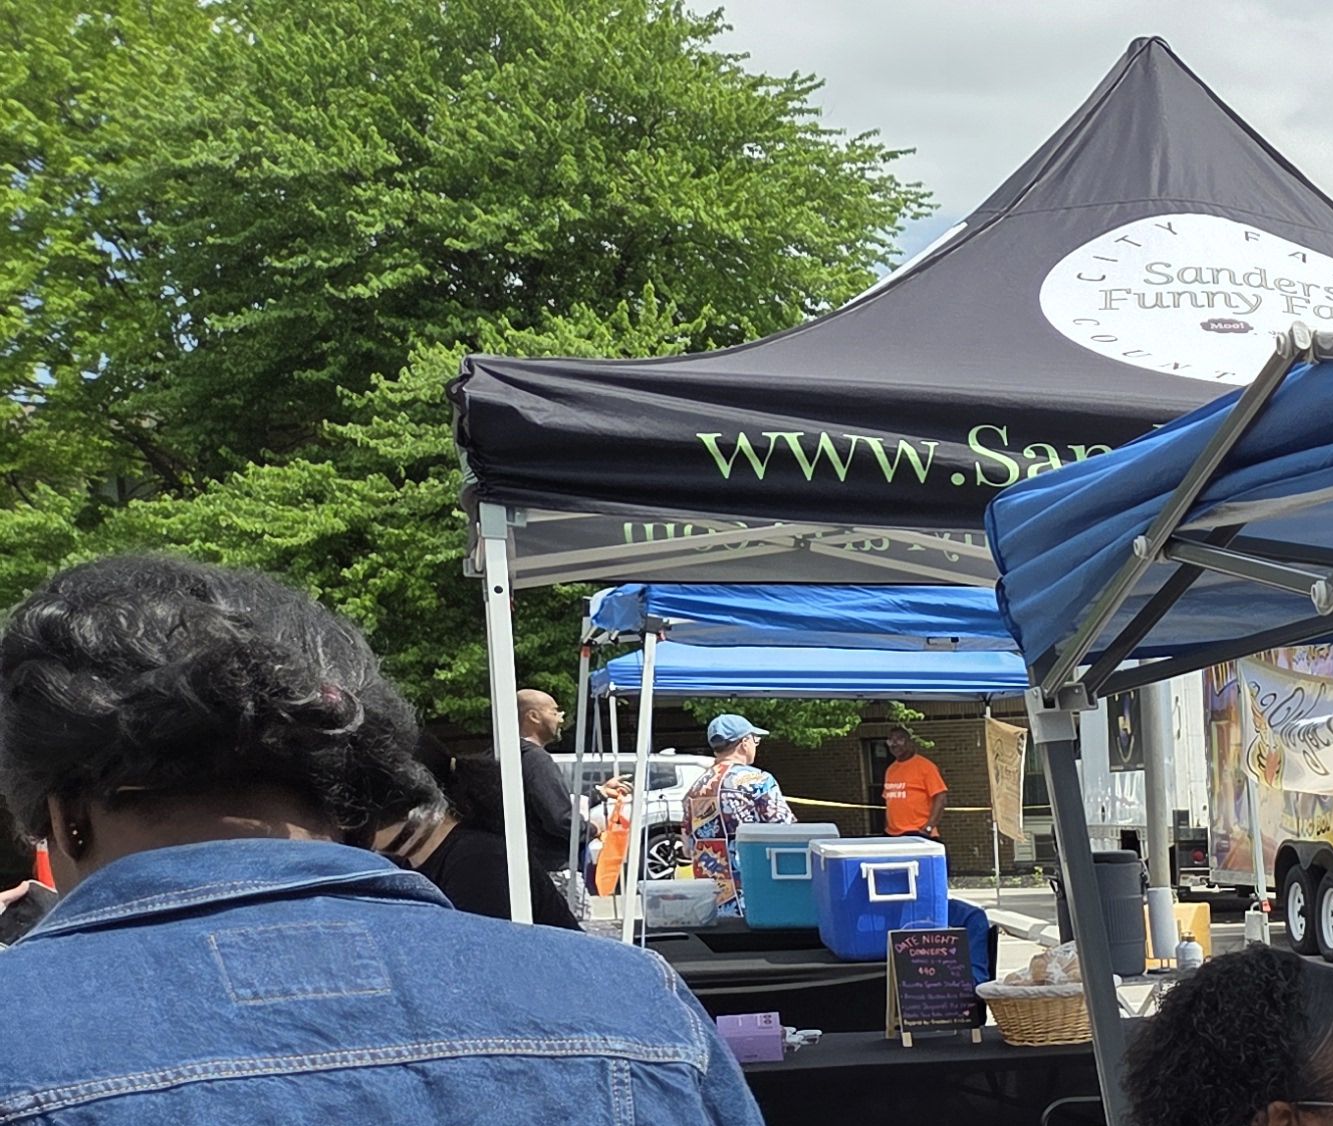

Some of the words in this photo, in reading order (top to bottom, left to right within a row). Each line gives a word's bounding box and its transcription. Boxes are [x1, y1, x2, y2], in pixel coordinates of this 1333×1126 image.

[1077, 221, 1178, 282] CITY
[1098, 288, 1263, 315] Funny
[696, 424, 1166, 487] www.Sa
[922, 934, 959, 945] NIGHT
